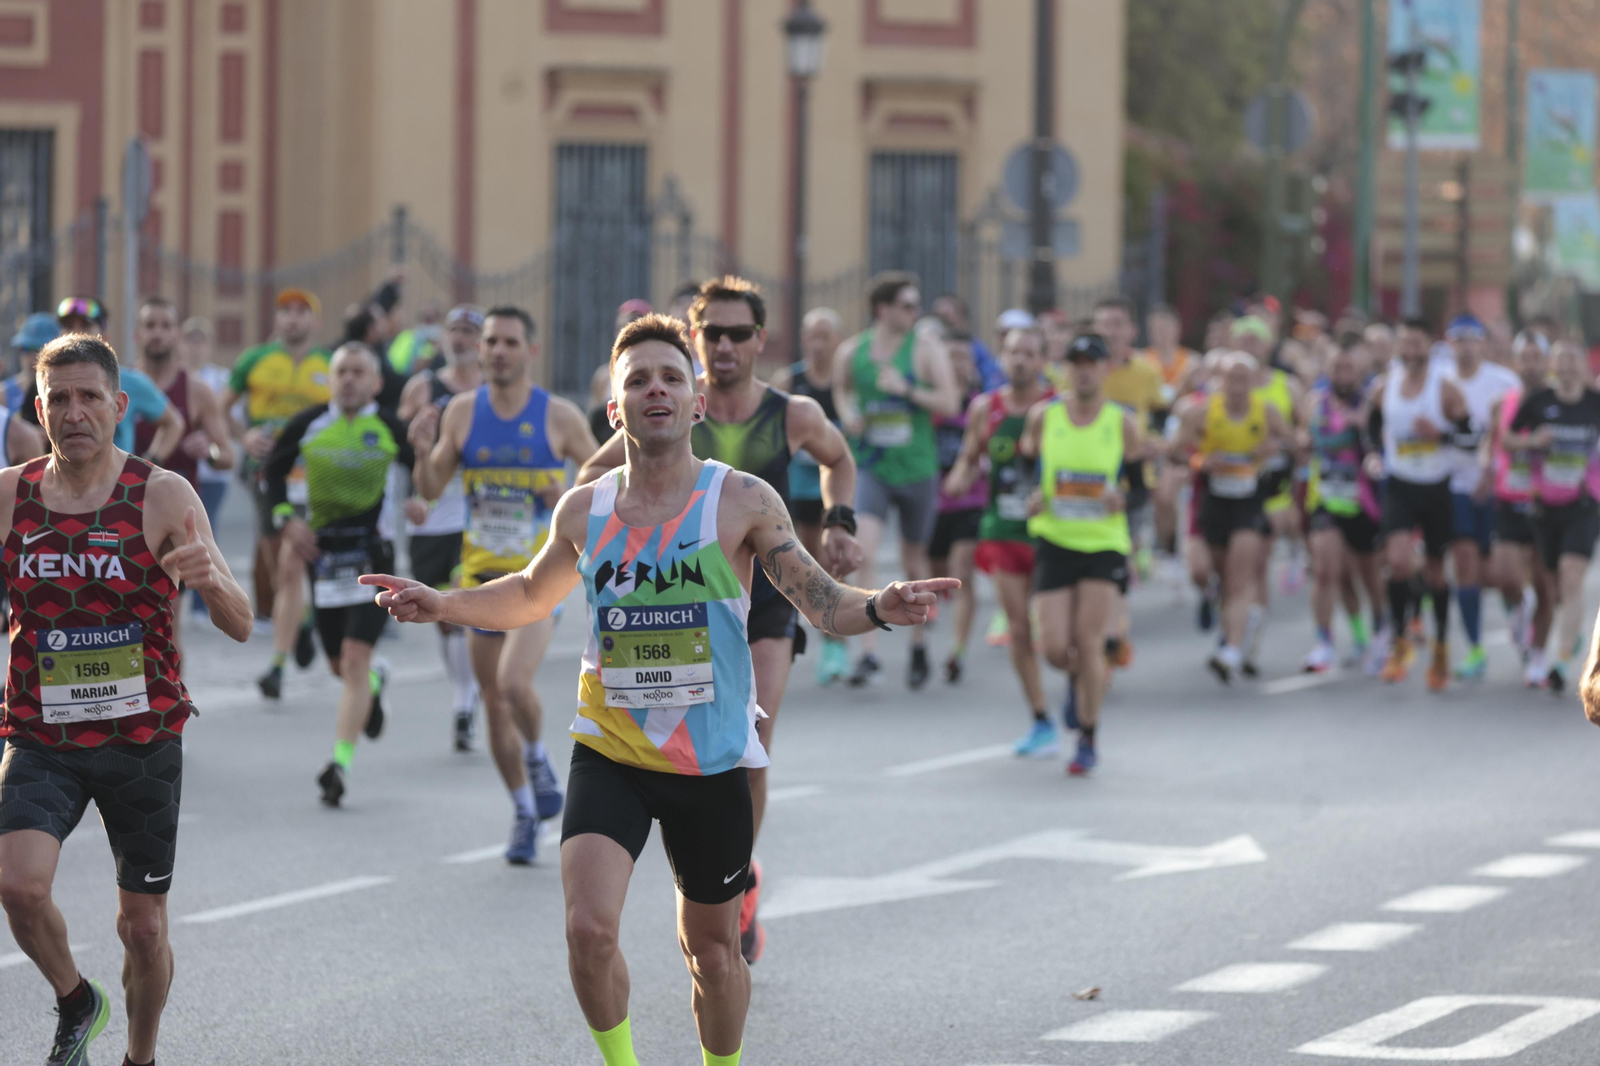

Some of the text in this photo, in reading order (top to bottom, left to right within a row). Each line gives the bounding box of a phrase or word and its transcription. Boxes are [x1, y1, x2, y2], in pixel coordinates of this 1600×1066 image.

[19, 553, 126, 580] KENYA
[595, 555, 706, 595] BERLIN
[630, 609, 694, 626] ZURICH
[71, 628, 130, 646] ZURICH
[633, 644, 671, 660] 1568
[74, 661, 110, 678] 1569
[636, 670, 672, 684] DAVID
[70, 684, 118, 700] MARIAN
